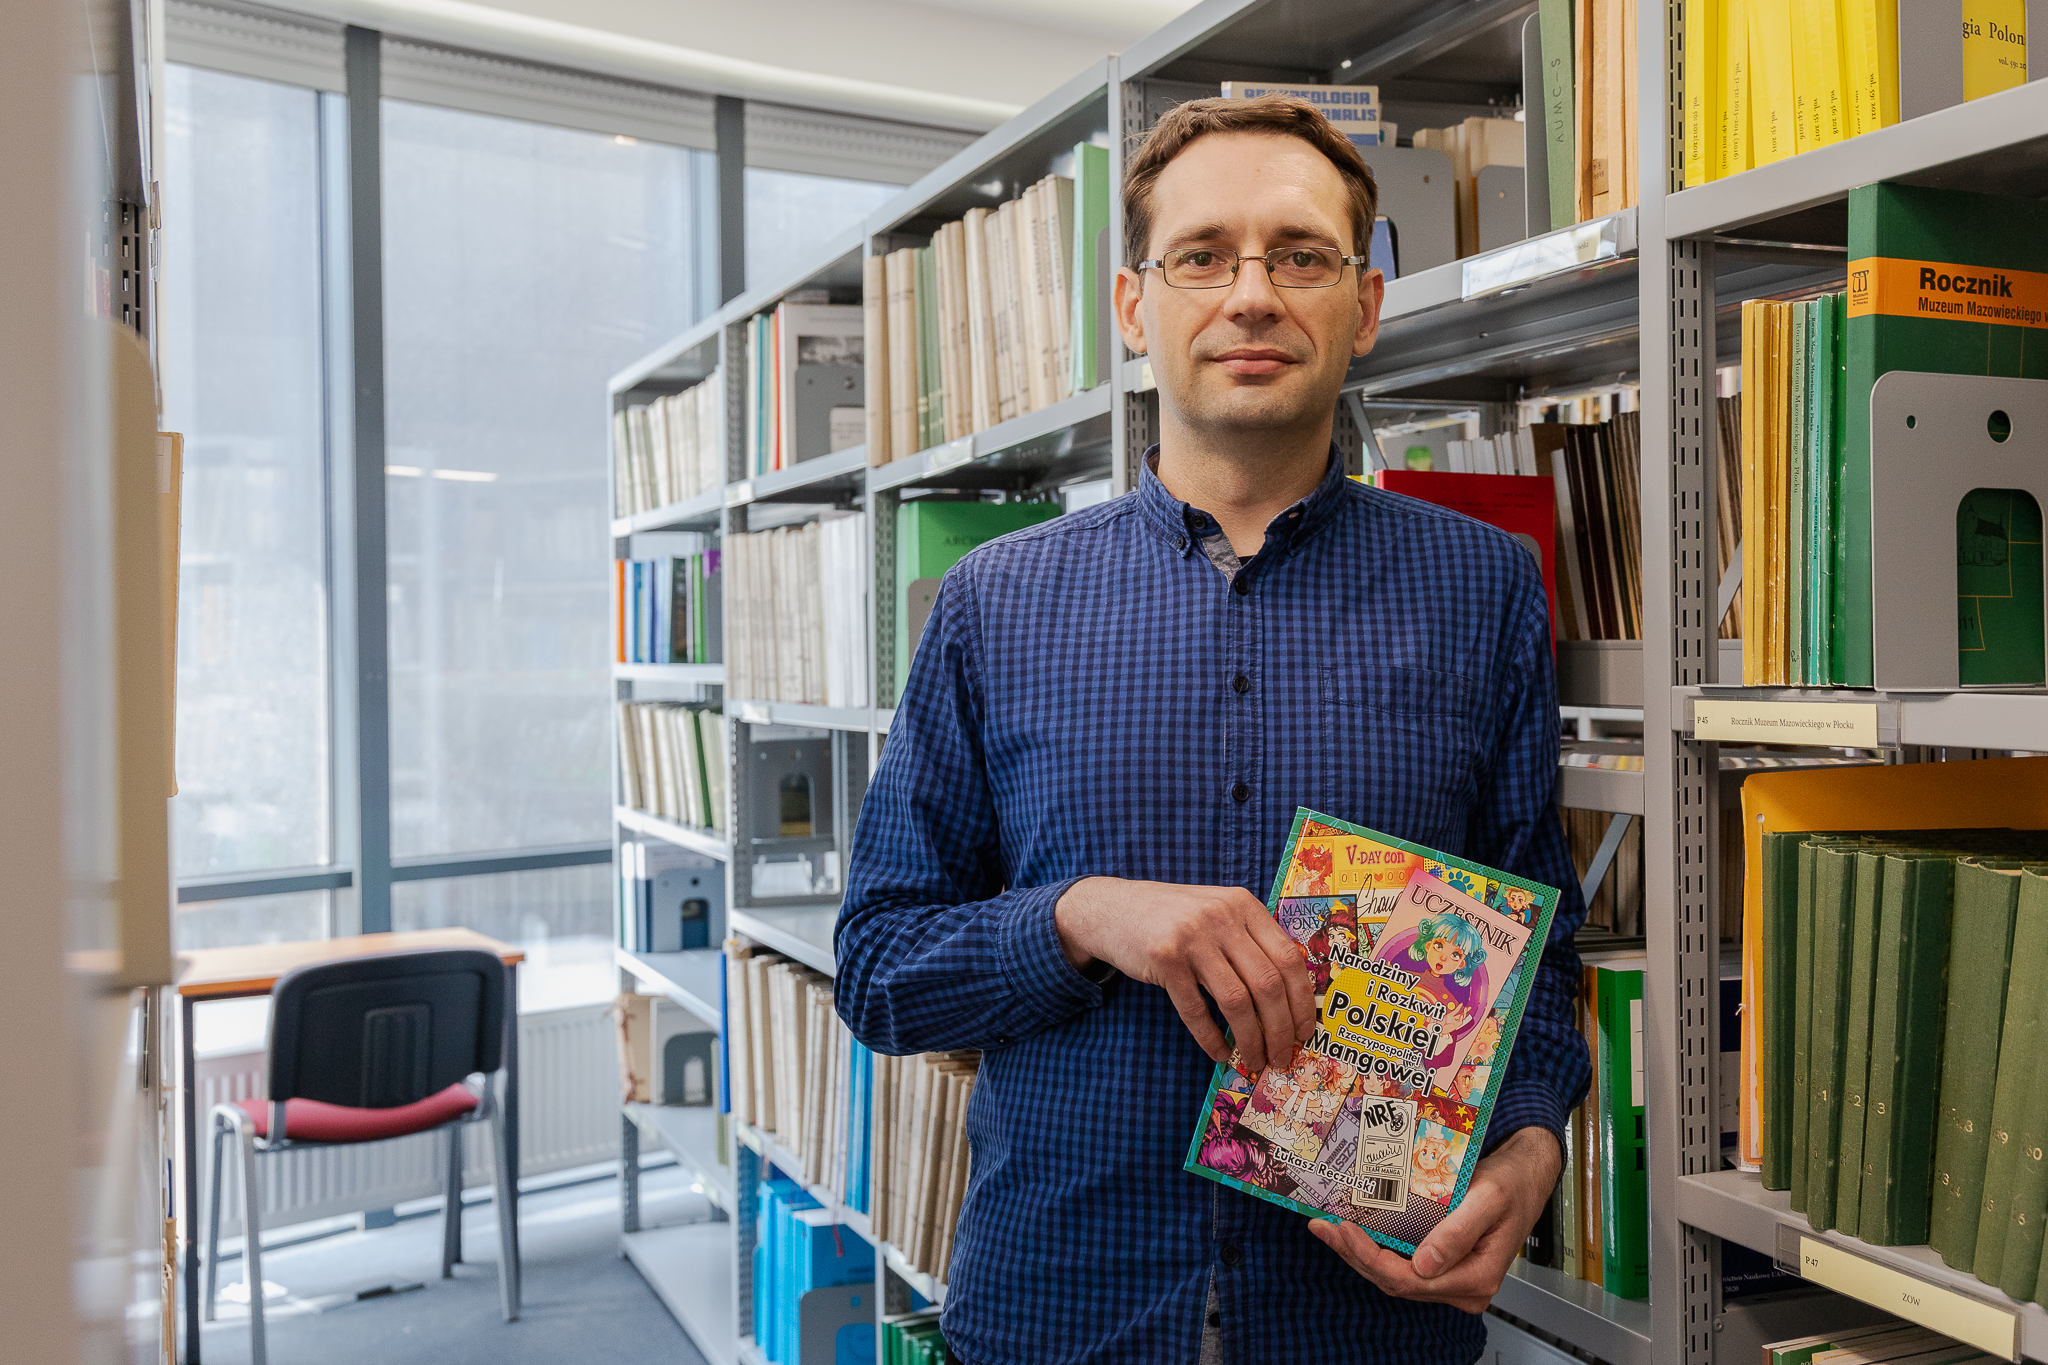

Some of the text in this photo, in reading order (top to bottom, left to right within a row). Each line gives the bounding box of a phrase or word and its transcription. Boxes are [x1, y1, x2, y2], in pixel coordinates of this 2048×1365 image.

[1962, 18, 2026, 46] gia Polon
[1797, 95, 1805, 109] vol.
[1813, 98, 1821, 112] vol.
[1830, 89, 1838, 104] vol.
[1919, 267, 2013, 298] Rocznik
[1918, 296, 1964, 315] Muzeum
[1967, 300, 2042, 325] Mazowieckiego
[1793, 395, 1801, 455] Mazowieckiego
[1731, 716, 1753, 725] Rocznik
[1754, 718, 1779, 727] Muzeum
[1779, 718, 1825, 730] Mazowieckiego
[1345, 844, 1382, 866] V-DAY
[1282, 902, 1332, 917] MANGA
[1411, 883, 1517, 956] UCZESTNIK
[1330, 943, 1420, 991] Narodziny
[1366, 979, 1447, 1021] i Rozkwit
[1327, 990, 1442, 1059] Polskiej
[1337, 1026, 1423, 1066] Rzeczypospolitej
[1304, 1029, 1436, 1097] Mangowej
[1273, 1146, 1376, 1195] Łukasz Reczulski
[1810, 1258, 1819, 1268] 47
[1901, 1292, 1921, 1307] ZOW
